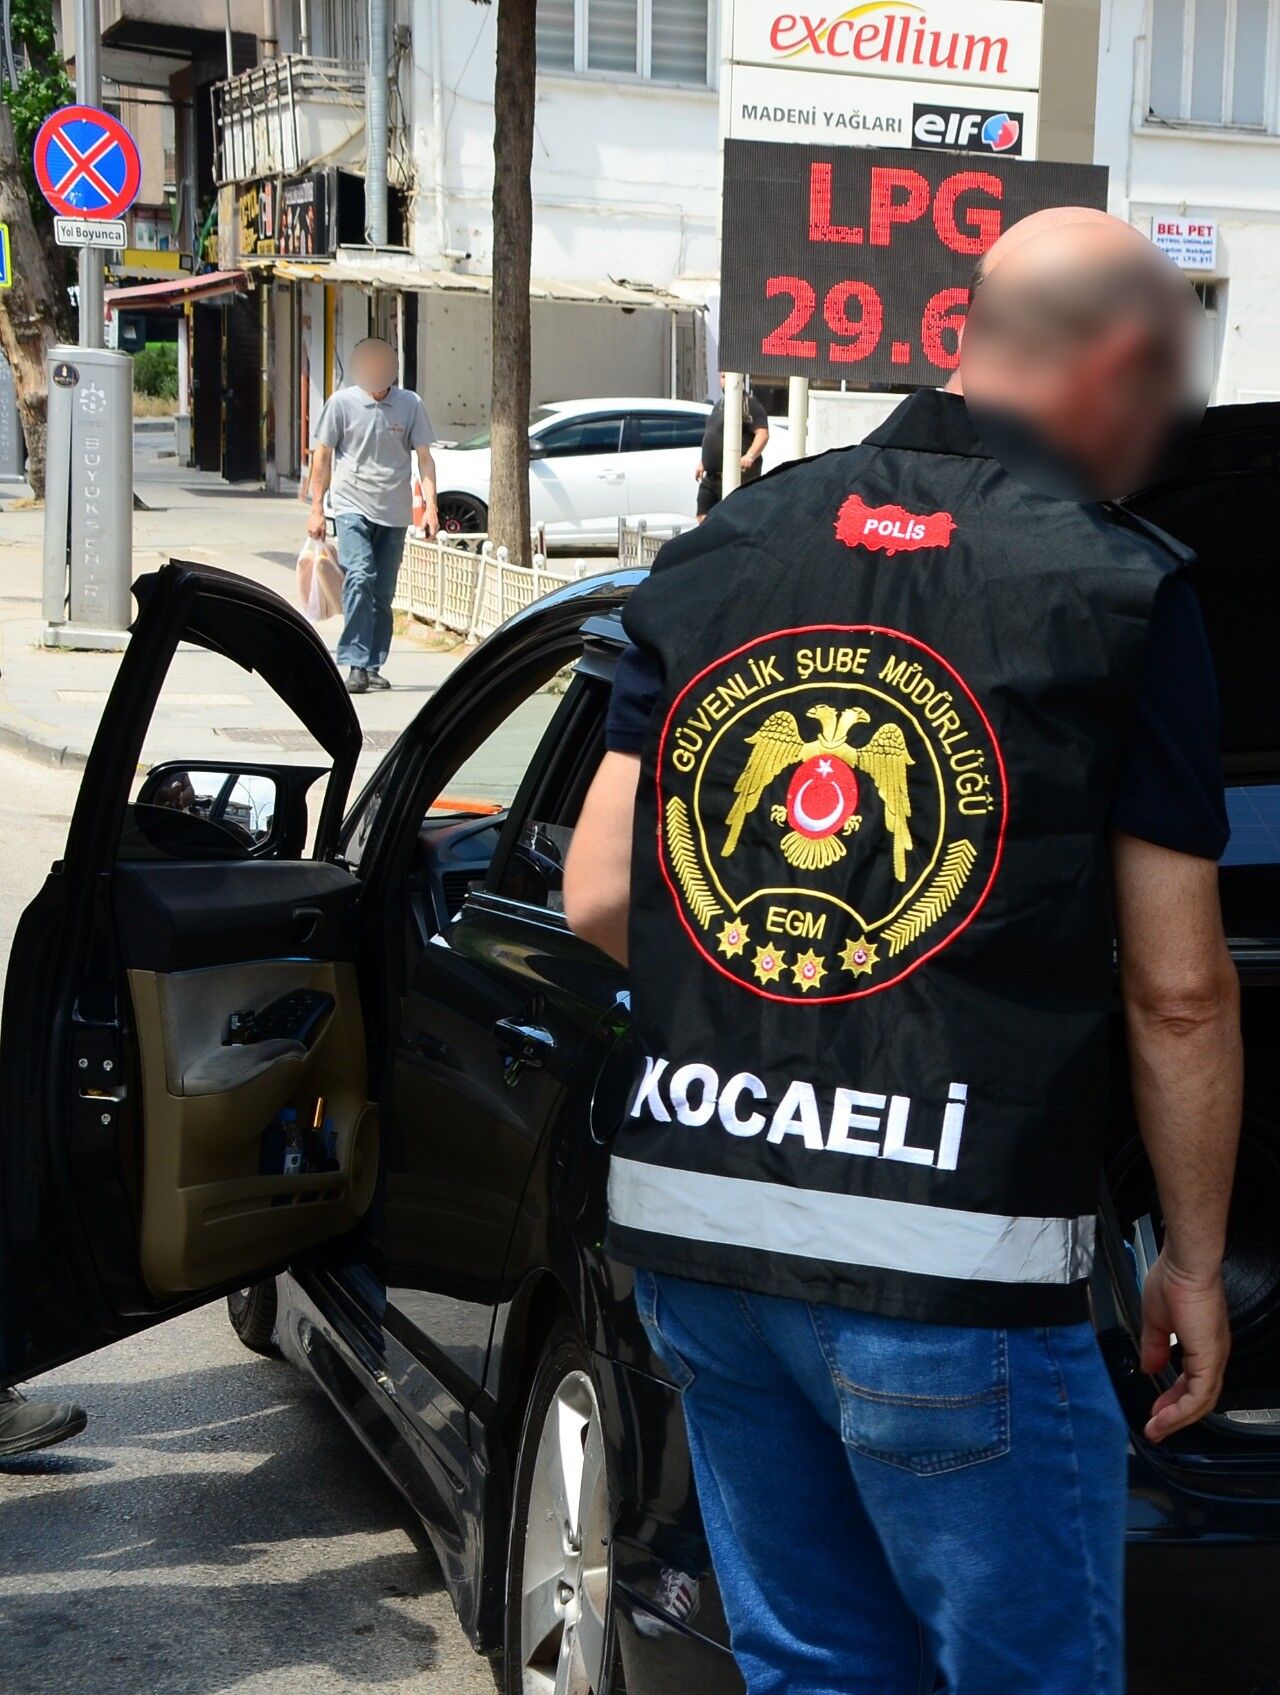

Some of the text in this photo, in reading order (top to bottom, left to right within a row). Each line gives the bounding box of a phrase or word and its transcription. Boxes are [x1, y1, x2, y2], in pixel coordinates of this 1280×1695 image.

[770, 15, 1009, 73] excellium
[741, 104, 903, 133] MADENİ YAĞLARI
[913, 113, 982, 145] elf
[808, 162, 1003, 254] LPG
[1157, 223, 1213, 237] BEL PET
[61, 226, 121, 241] Yol Boyunca
[762, 276, 971, 369] 29.6
[672, 647, 995, 816] GÜVENLİK ŞUBE MÜDÜRLÜĞÜ
[766, 905, 827, 941] EGM
[629, 1055, 969, 1171] KOCAELİ
